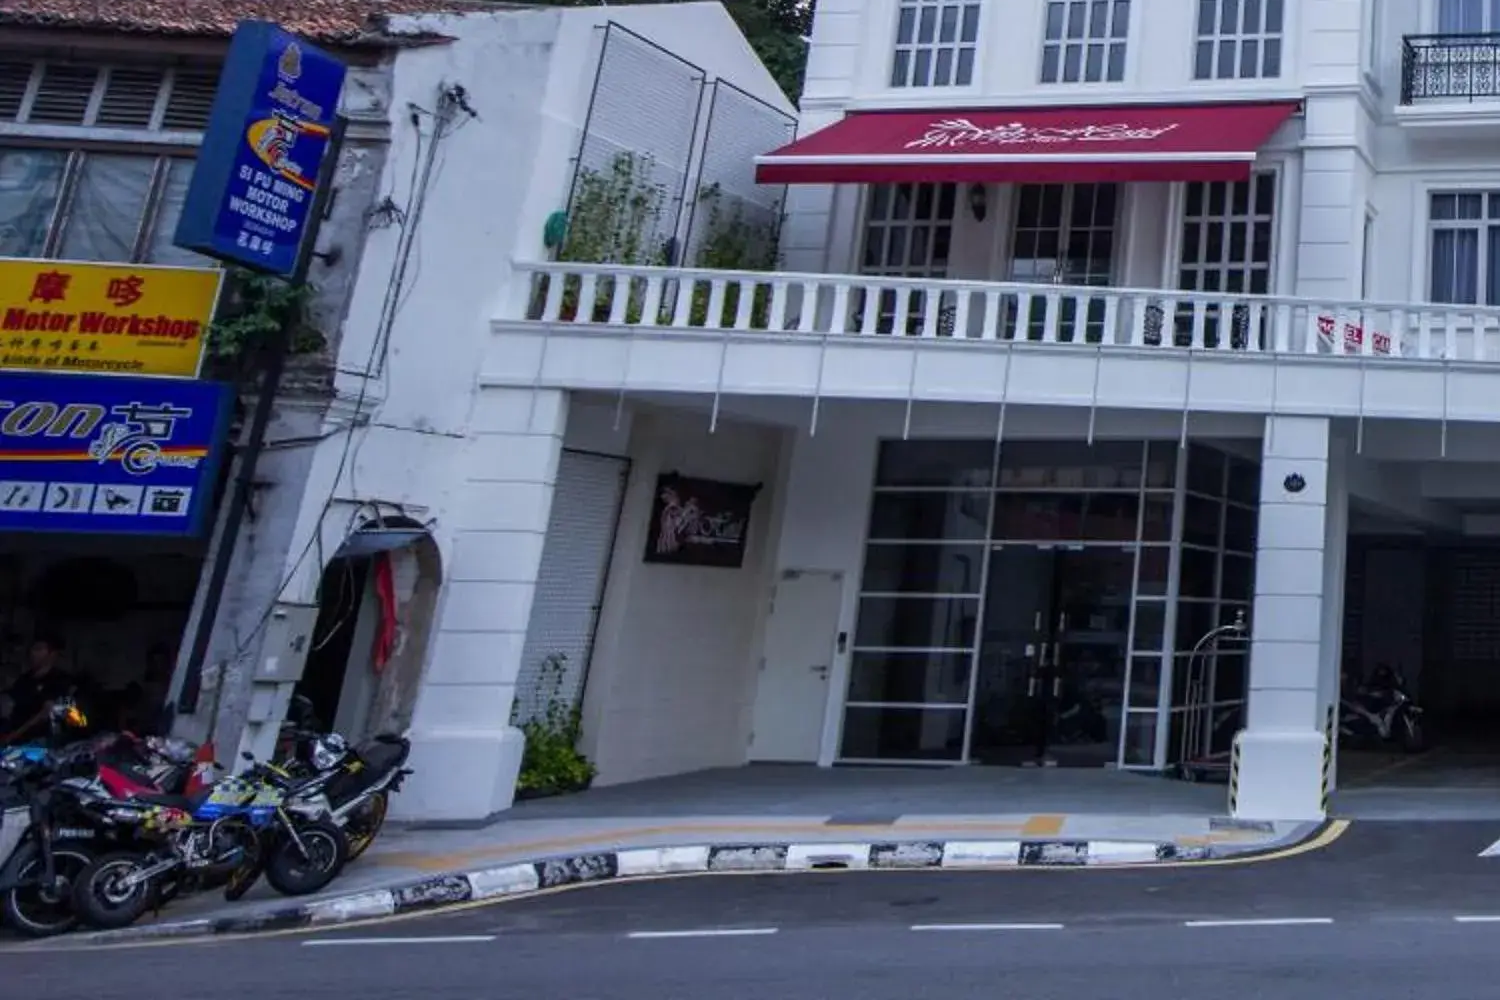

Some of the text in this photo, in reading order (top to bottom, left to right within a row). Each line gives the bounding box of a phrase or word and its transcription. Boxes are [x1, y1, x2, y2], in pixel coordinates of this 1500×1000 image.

[246, 185, 289, 213] MOTOR
[254, 171, 272, 189] PU
[272, 179, 305, 202] MING
[229, 194, 297, 232] WORKSHOP
[2, 308, 201, 340] Motor Workshop
[0, 401, 106, 438] on
